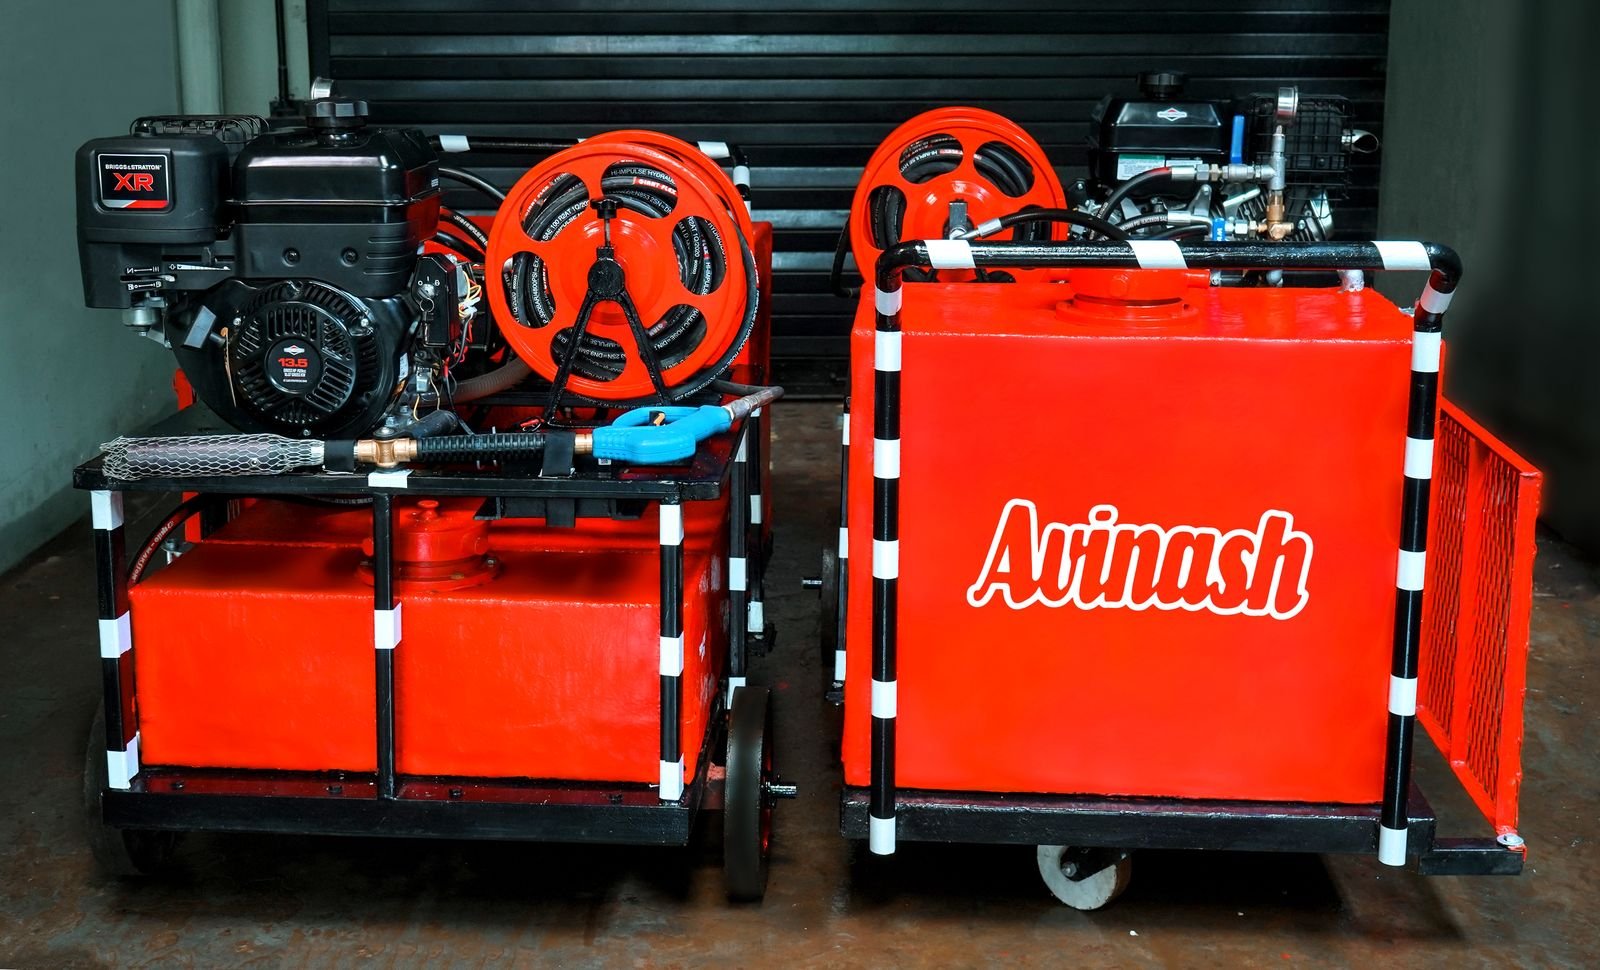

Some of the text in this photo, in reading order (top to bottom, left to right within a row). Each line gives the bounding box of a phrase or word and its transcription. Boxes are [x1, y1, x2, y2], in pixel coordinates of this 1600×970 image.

[113, 172, 154, 191] XR
[638, 178, 660, 188] GIANT
[542, 229, 553, 241] SAE
[550, 219, 560, 229] 100
[669, 326, 686, 342] HOSE
[278, 358, 308, 368] 13.5
[966, 498, 1314, 620] Avinash
